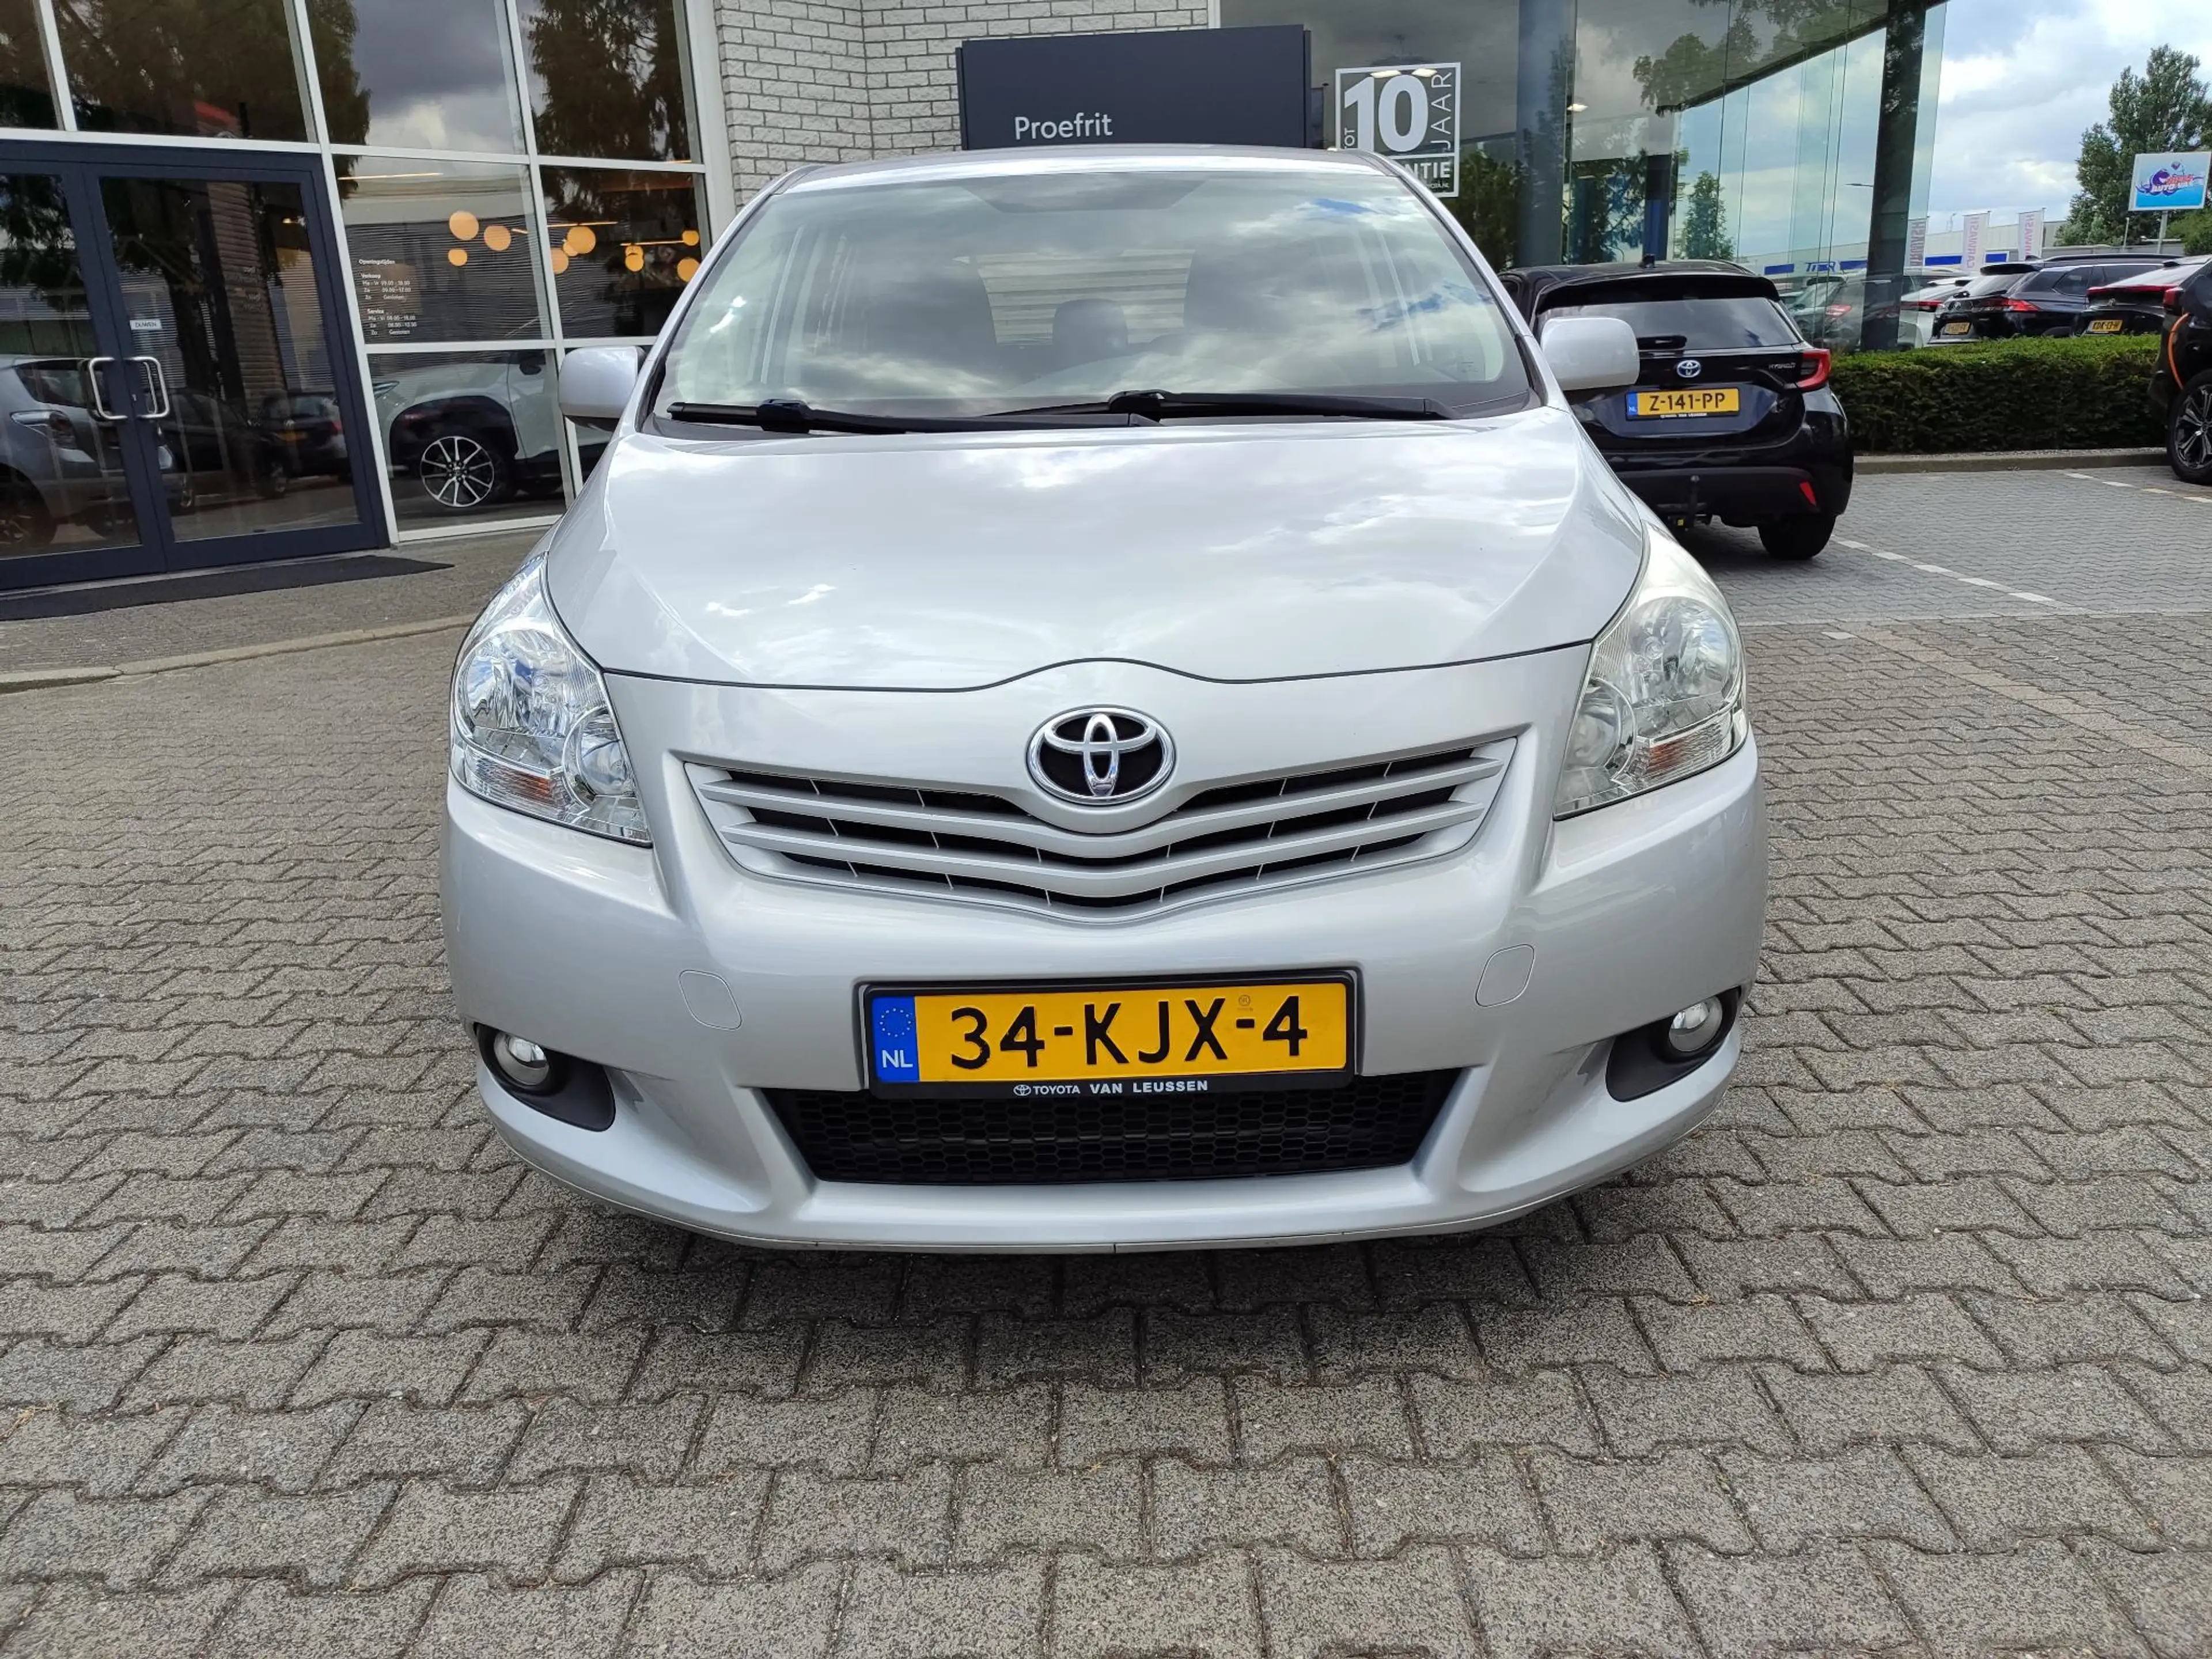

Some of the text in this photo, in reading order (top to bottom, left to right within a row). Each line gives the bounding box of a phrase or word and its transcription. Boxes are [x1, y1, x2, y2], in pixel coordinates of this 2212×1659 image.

[1344, 72, 1452, 151] OT 10 JAAR
[1015, 112, 1113, 140] Proefrit
[1649, 393, 1725, 411] Z-141-PP
[882, 996, 1308, 1069] NL 34-KJX-4
[1033, 1080, 1207, 1094] TOYOTA VAN LEUSSEN
